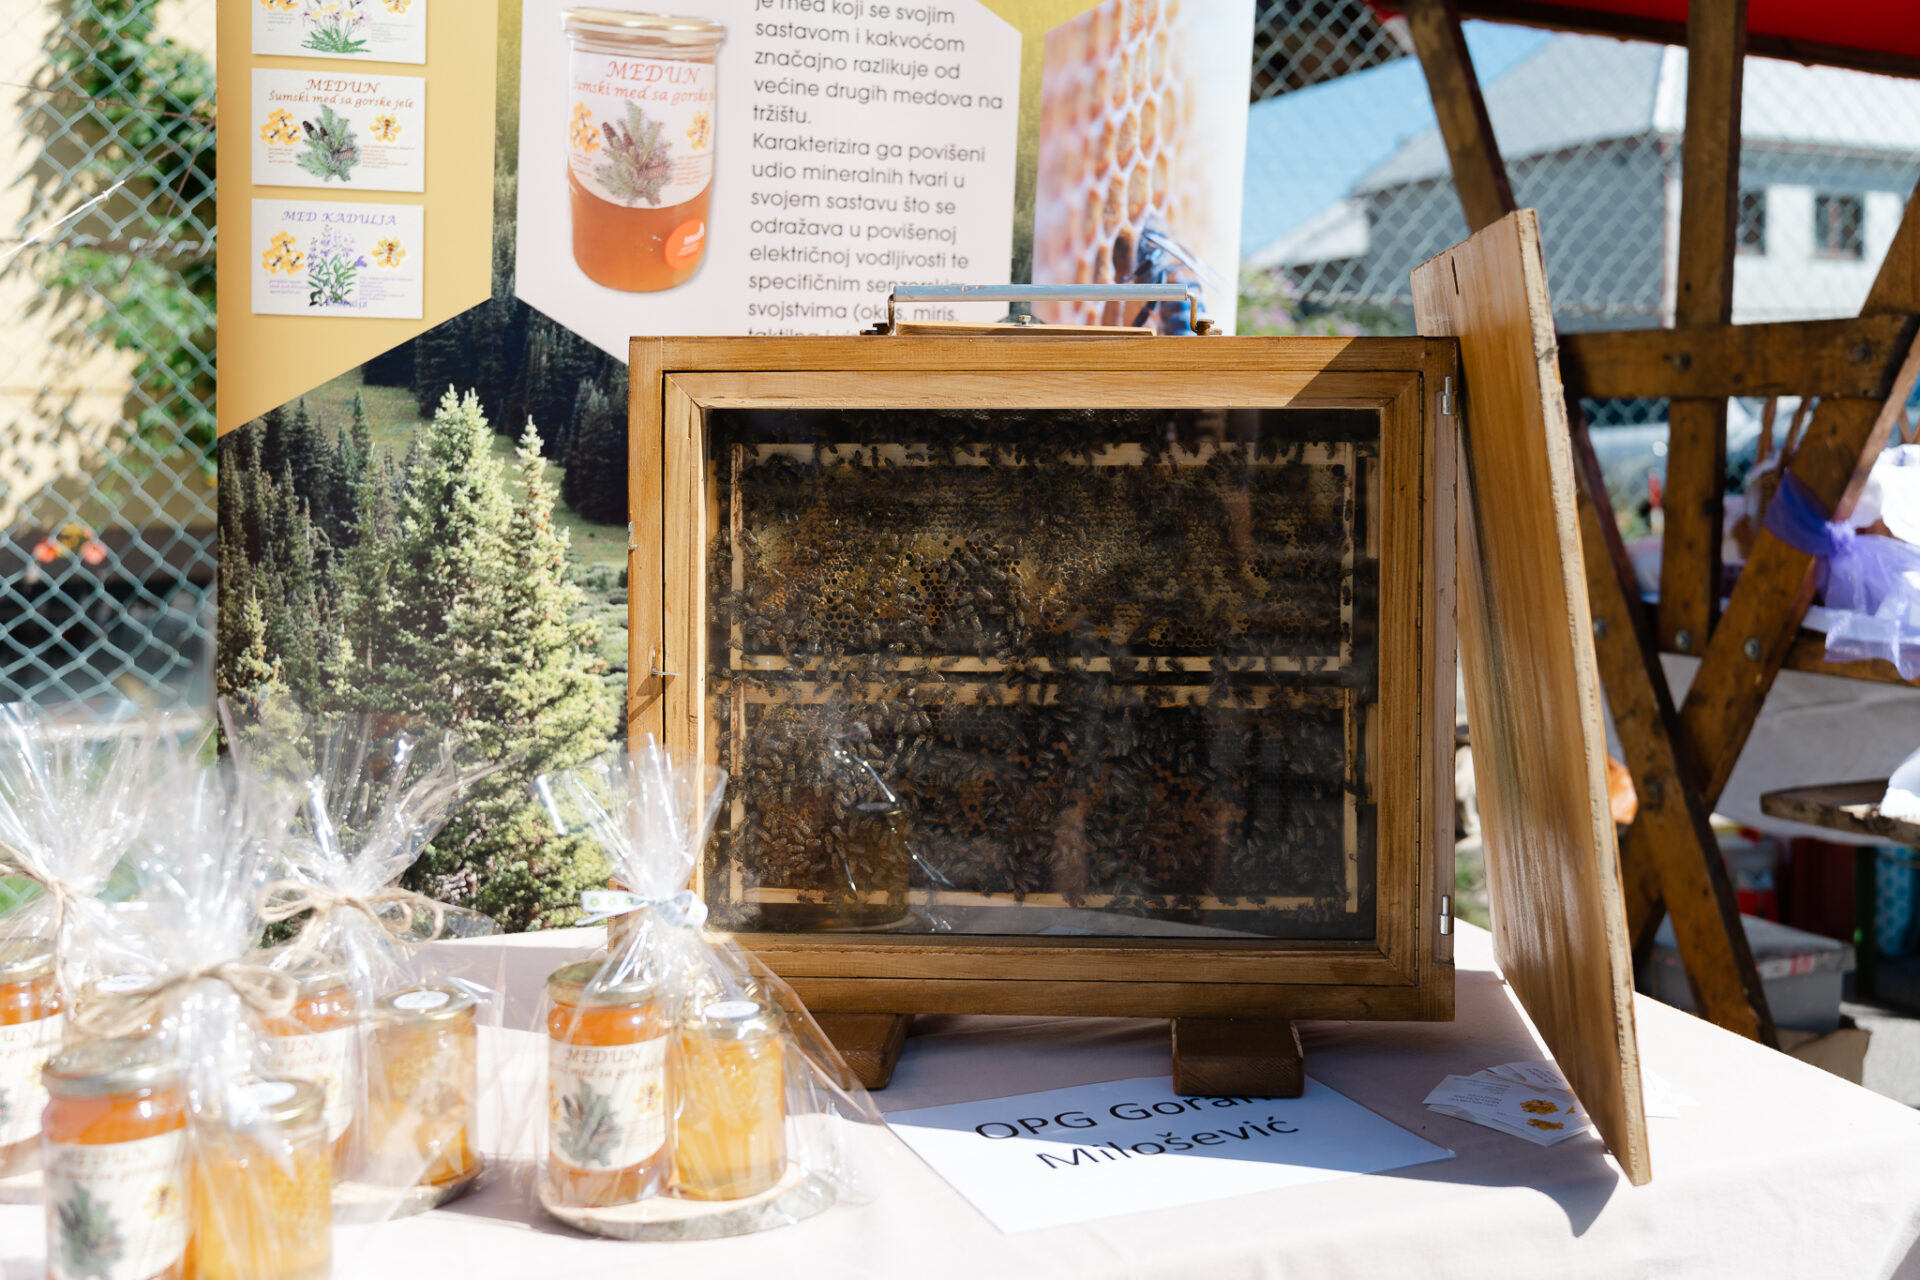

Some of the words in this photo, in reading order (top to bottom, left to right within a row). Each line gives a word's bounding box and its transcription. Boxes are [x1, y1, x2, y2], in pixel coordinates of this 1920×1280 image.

[779, 0, 825, 13] med
[832, 0, 863, 20] koji
[869, 4, 890, 19] se
[896, 6, 955, 26] svojim
[755, 22, 850, 43] sastavom
[855, 28, 860, 44] i
[866, 28, 965, 52] kakvoćom
[606, 61, 701, 84] MEDUN
[754, 49, 847, 72] značajno
[853, 58, 928, 80] razlikuje
[934, 64, 960, 79] od
[268, 89, 310, 103] Šumski
[313, 94, 339, 104] med
[340, 97, 352, 105] sa
[354, 96, 392, 108] gorske
[394, 98, 414, 109] jele
[305, 79, 381, 94] MEDUN
[614, 85, 651, 100] med
[652, 90, 668, 101] sa
[754, 77, 820, 97] većine
[826, 82, 887, 104] drugih
[893, 89, 972, 107] medova
[978, 96, 1003, 110] na
[753, 105, 812, 124] tržištu.
[753, 132, 870, 155] Karakterizira
[876, 143, 902, 160] ga
[908, 144, 985, 162] povišeni
[752, 162, 796, 179] udio
[802, 165, 903, 184] mineralnih
[909, 170, 948, 188] tvari
[954, 176, 965, 188] u
[751, 190, 820, 210] svojem
[826, 194, 897, 212] sastavu
[903, 196, 930, 214] što
[935, 200, 956, 214] se
[281, 210, 318, 222] MED
[321, 212, 397, 226] KADULJA
[750, 218, 843, 237] odražava
[850, 225, 861, 238] u
[867, 223, 957, 246] povišenoj
[750, 245, 850, 268] električnoj
[856, 251, 946, 270] vodljivosti
[951, 254, 969, 269] te
[748, 274, 860, 292] specifičnim
[748, 301, 847, 321] svojstvima
[975, 1111, 1098, 1140] OPG
[1035, 1116, 1299, 1169] Milošević
